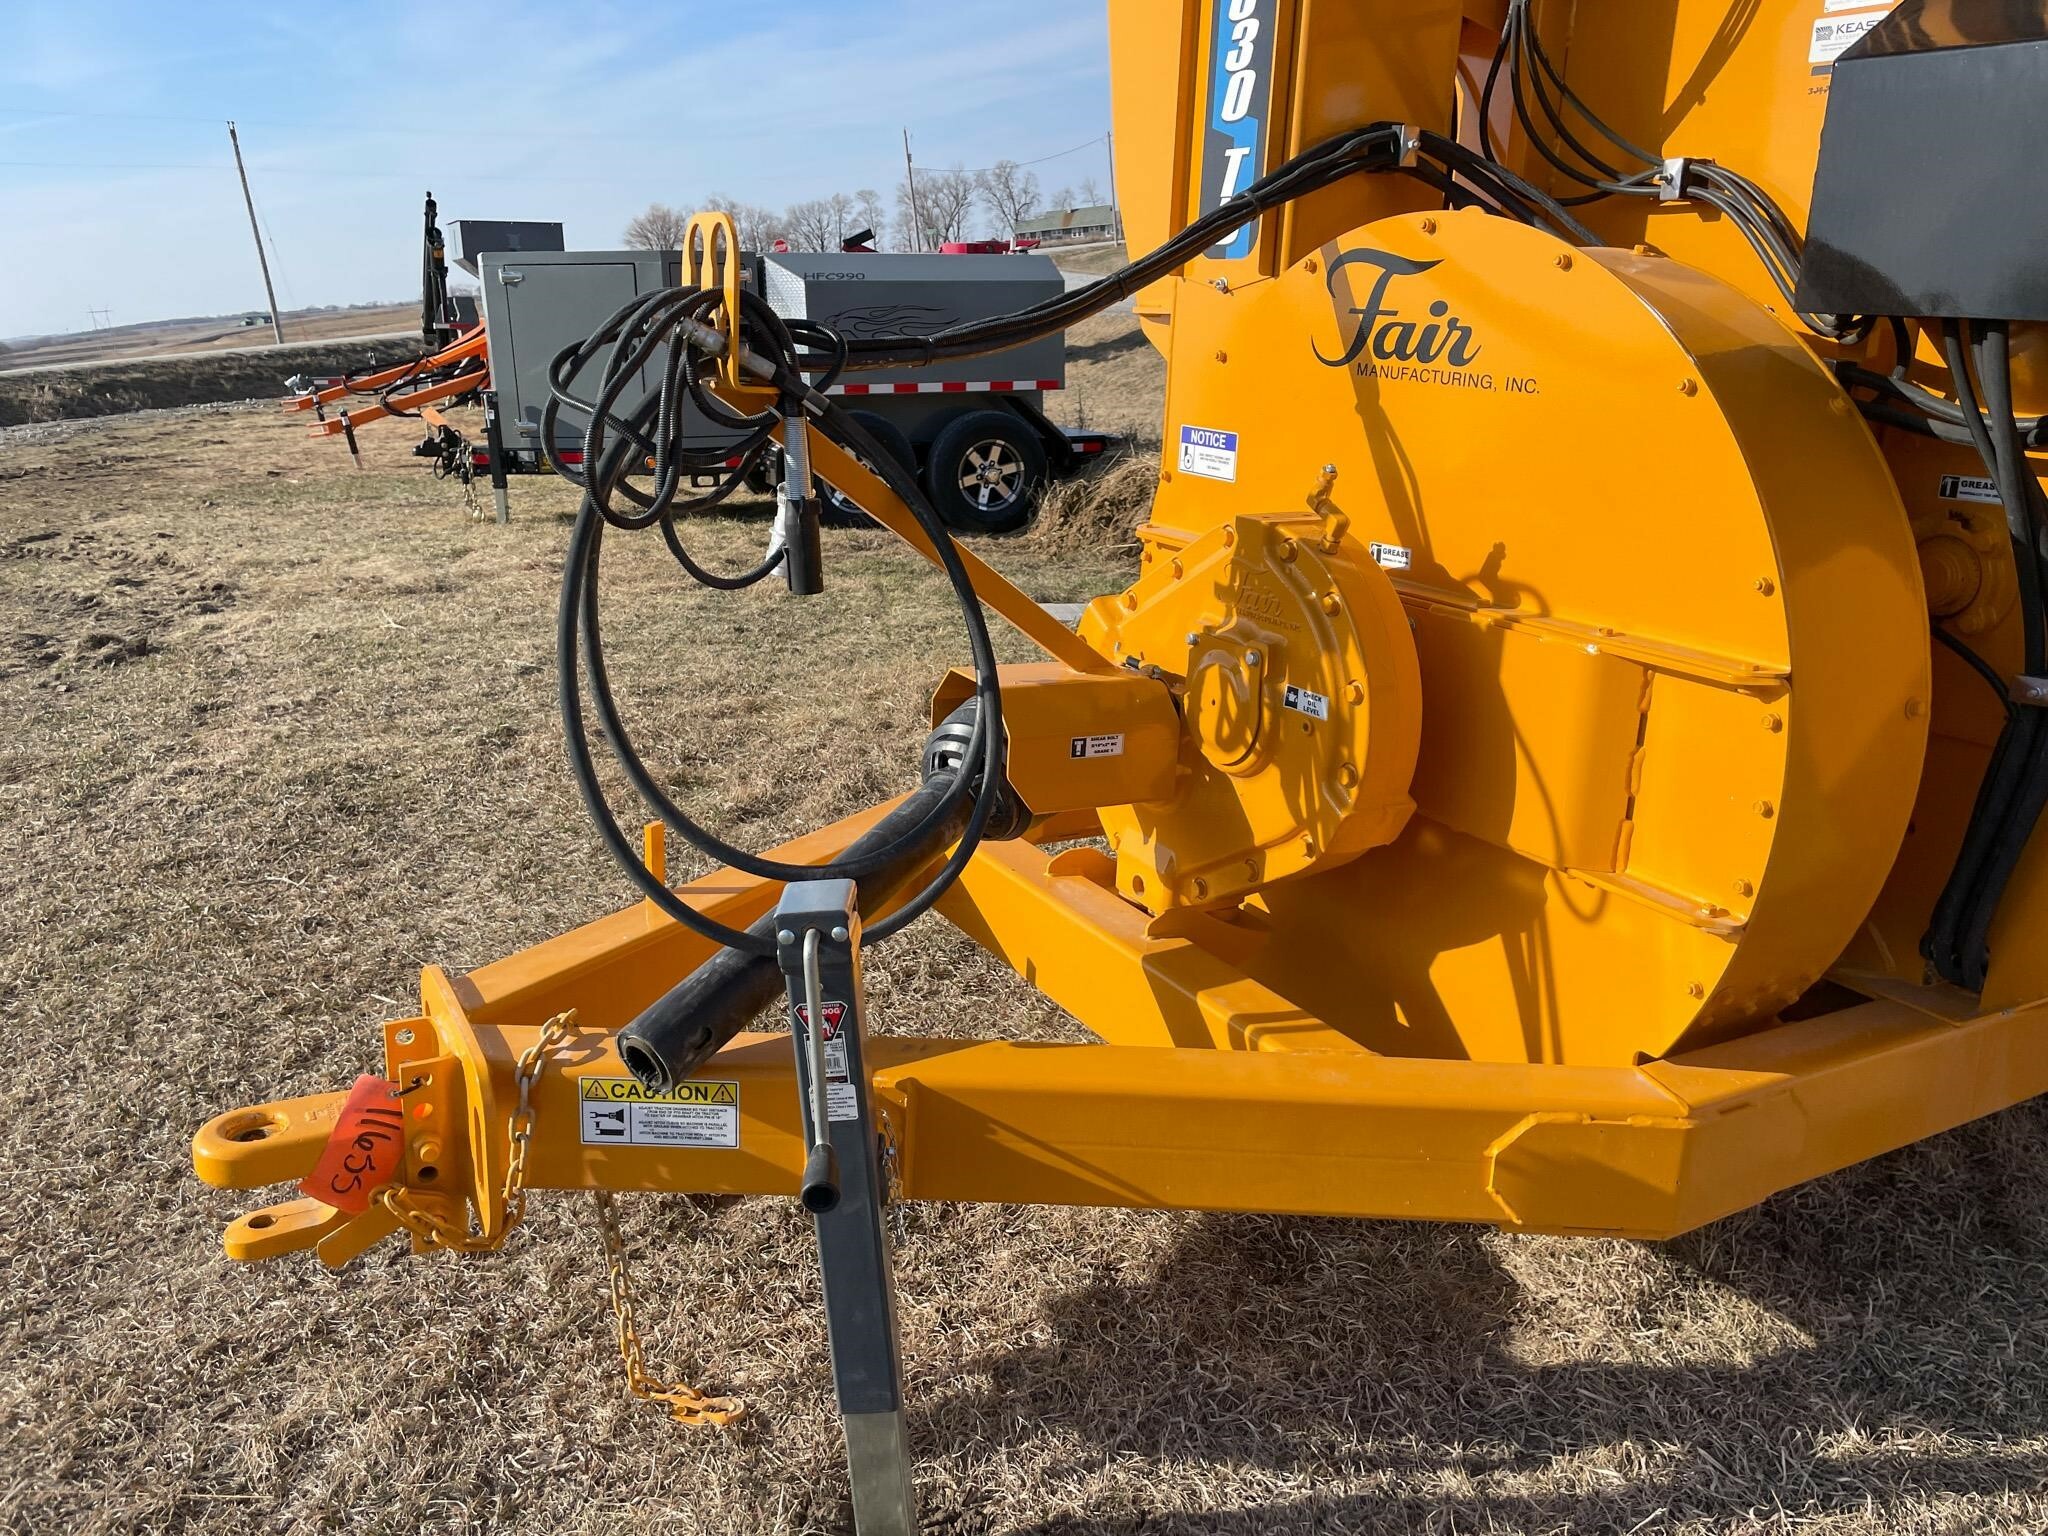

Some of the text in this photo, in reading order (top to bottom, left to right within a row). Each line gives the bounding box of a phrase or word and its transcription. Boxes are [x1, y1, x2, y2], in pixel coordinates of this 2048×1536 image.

[1836, 20, 1881, 35] KEAS
[803, 272, 866, 281] HFC990
[1311, 248, 1482, 367] Fair
[1356, 362, 1541, 394] MANUFACTURING, INC.
[1190, 430, 1227, 449] NOTICE
[1961, 480, 1996, 491] GREAS
[1382, 547, 1410, 559] GREASE
[1303, 706, 1320, 716] LEVEL
[1307, 700, 1317, 708] OIL
[610, 1083, 709, 1101] CAUION
[331, 1108, 403, 1194] 11655
